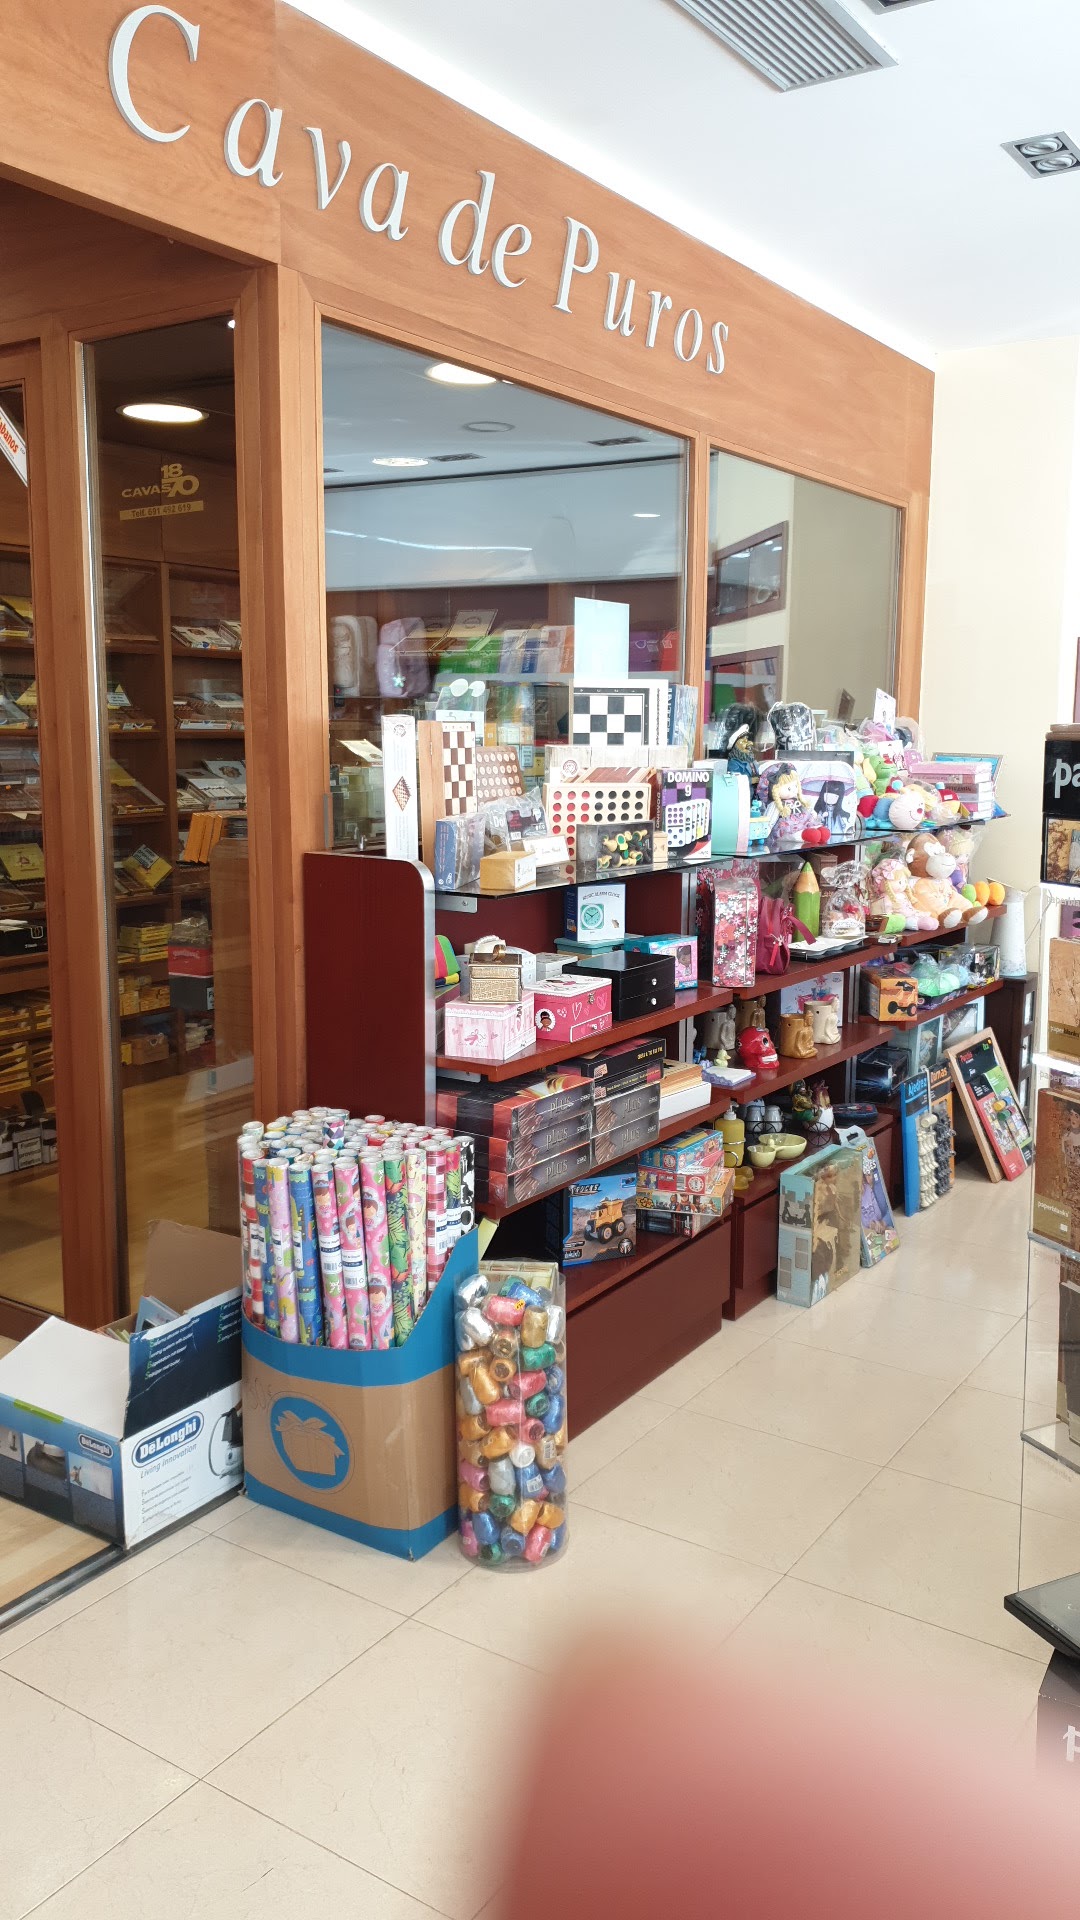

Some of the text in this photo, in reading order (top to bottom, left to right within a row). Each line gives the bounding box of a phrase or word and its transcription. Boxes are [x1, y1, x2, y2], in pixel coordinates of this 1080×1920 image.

[108, 4, 730, 375] Cava de Puros
[667, 771, 709, 782] DOMINO
[162, 1443, 197, 1467] innovation
